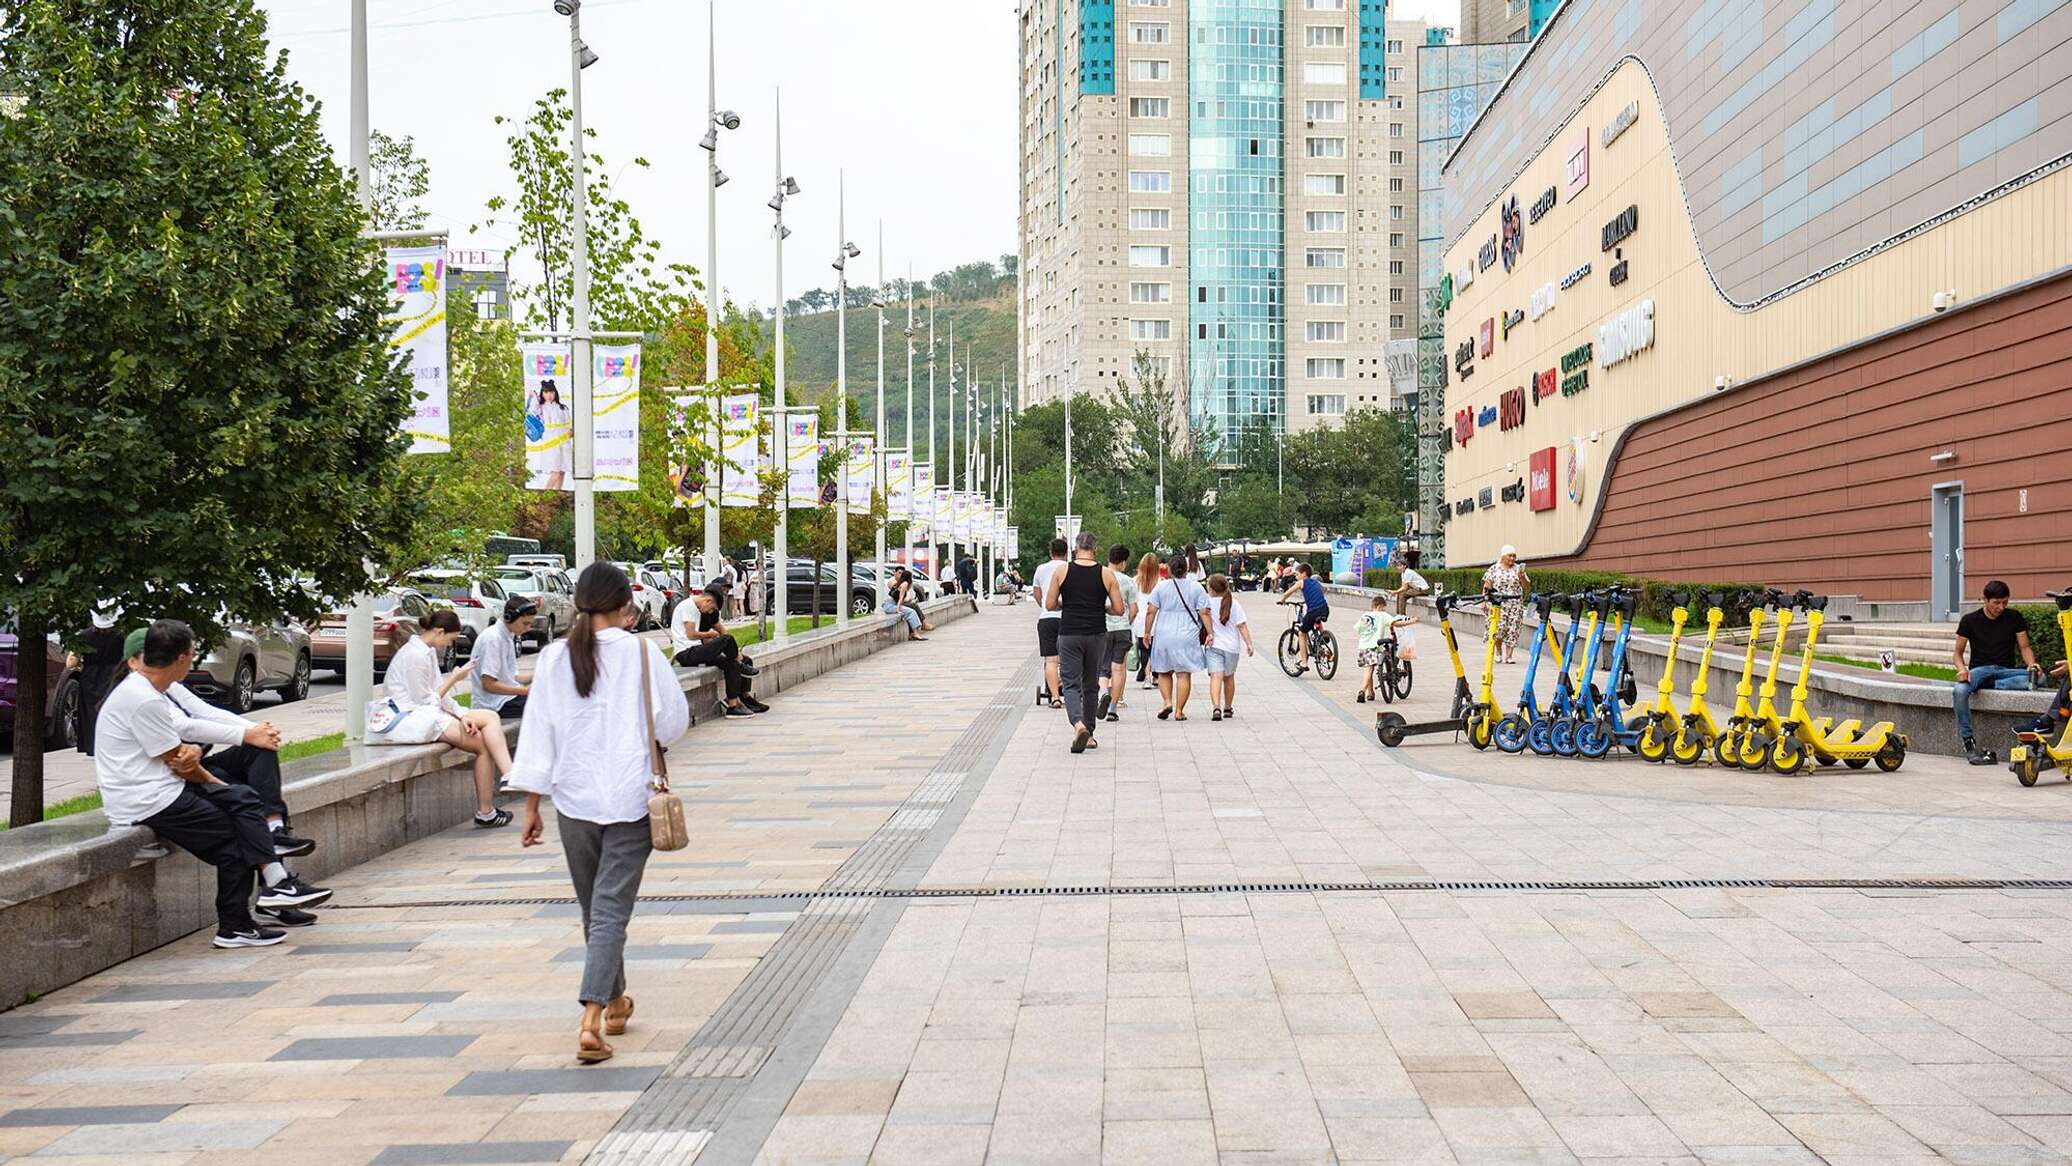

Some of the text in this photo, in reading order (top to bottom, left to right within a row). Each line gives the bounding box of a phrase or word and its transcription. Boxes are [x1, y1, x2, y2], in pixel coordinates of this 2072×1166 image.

[448, 250, 492, 264] OTEL
[1500, 386, 1525, 432] HUGO
[1531, 468, 1549, 492] Miele
